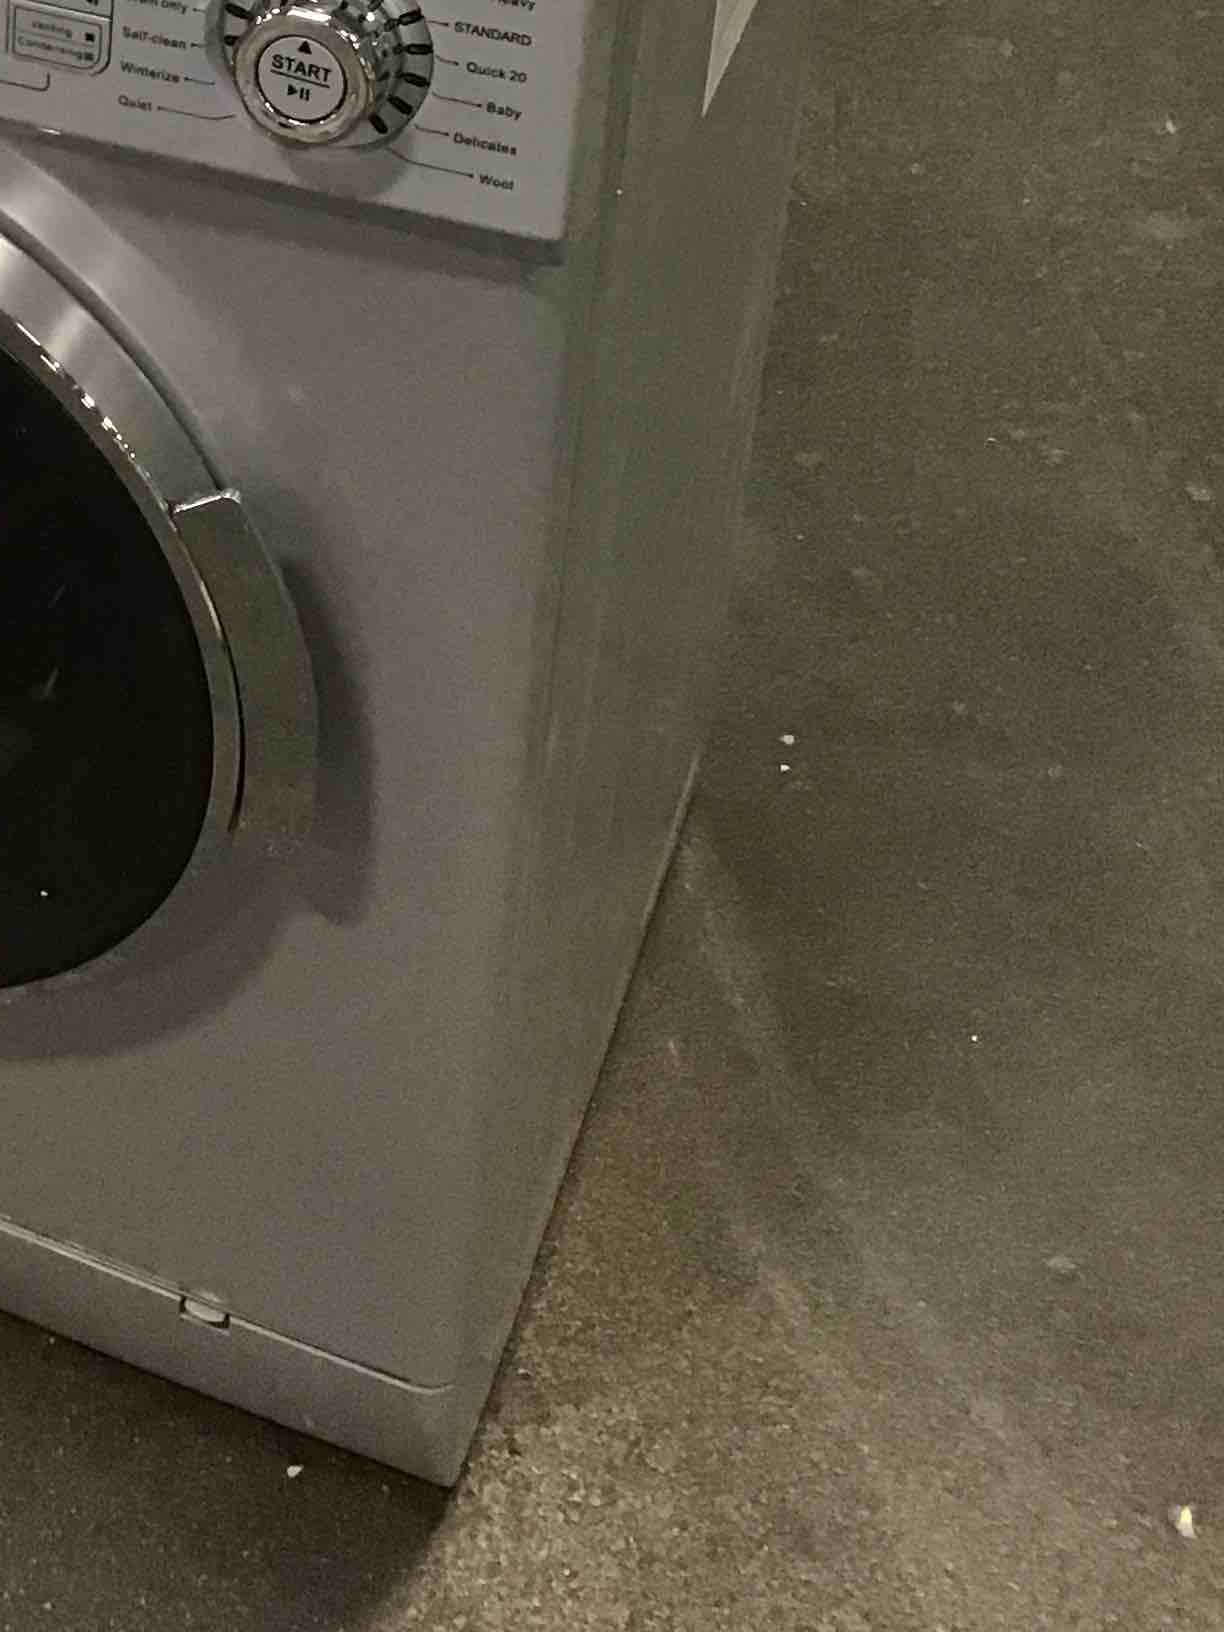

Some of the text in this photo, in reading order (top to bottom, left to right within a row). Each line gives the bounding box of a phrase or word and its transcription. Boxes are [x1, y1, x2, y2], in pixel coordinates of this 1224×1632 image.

[160, 0, 187, 15] only
[122, 25, 187, 50] Self-clean
[454, 21, 532, 46] STANDARD
[119, 60, 180, 84] Winterize
[271, 54, 332, 82] START
[466, 61, 527, 83] Quick 20
[117, 95, 152, 112] Quiet
[486, 101, 522, 120] Baby
[453, 131, 517, 156] Delicates
[479, 173, 514, 191] Wool
